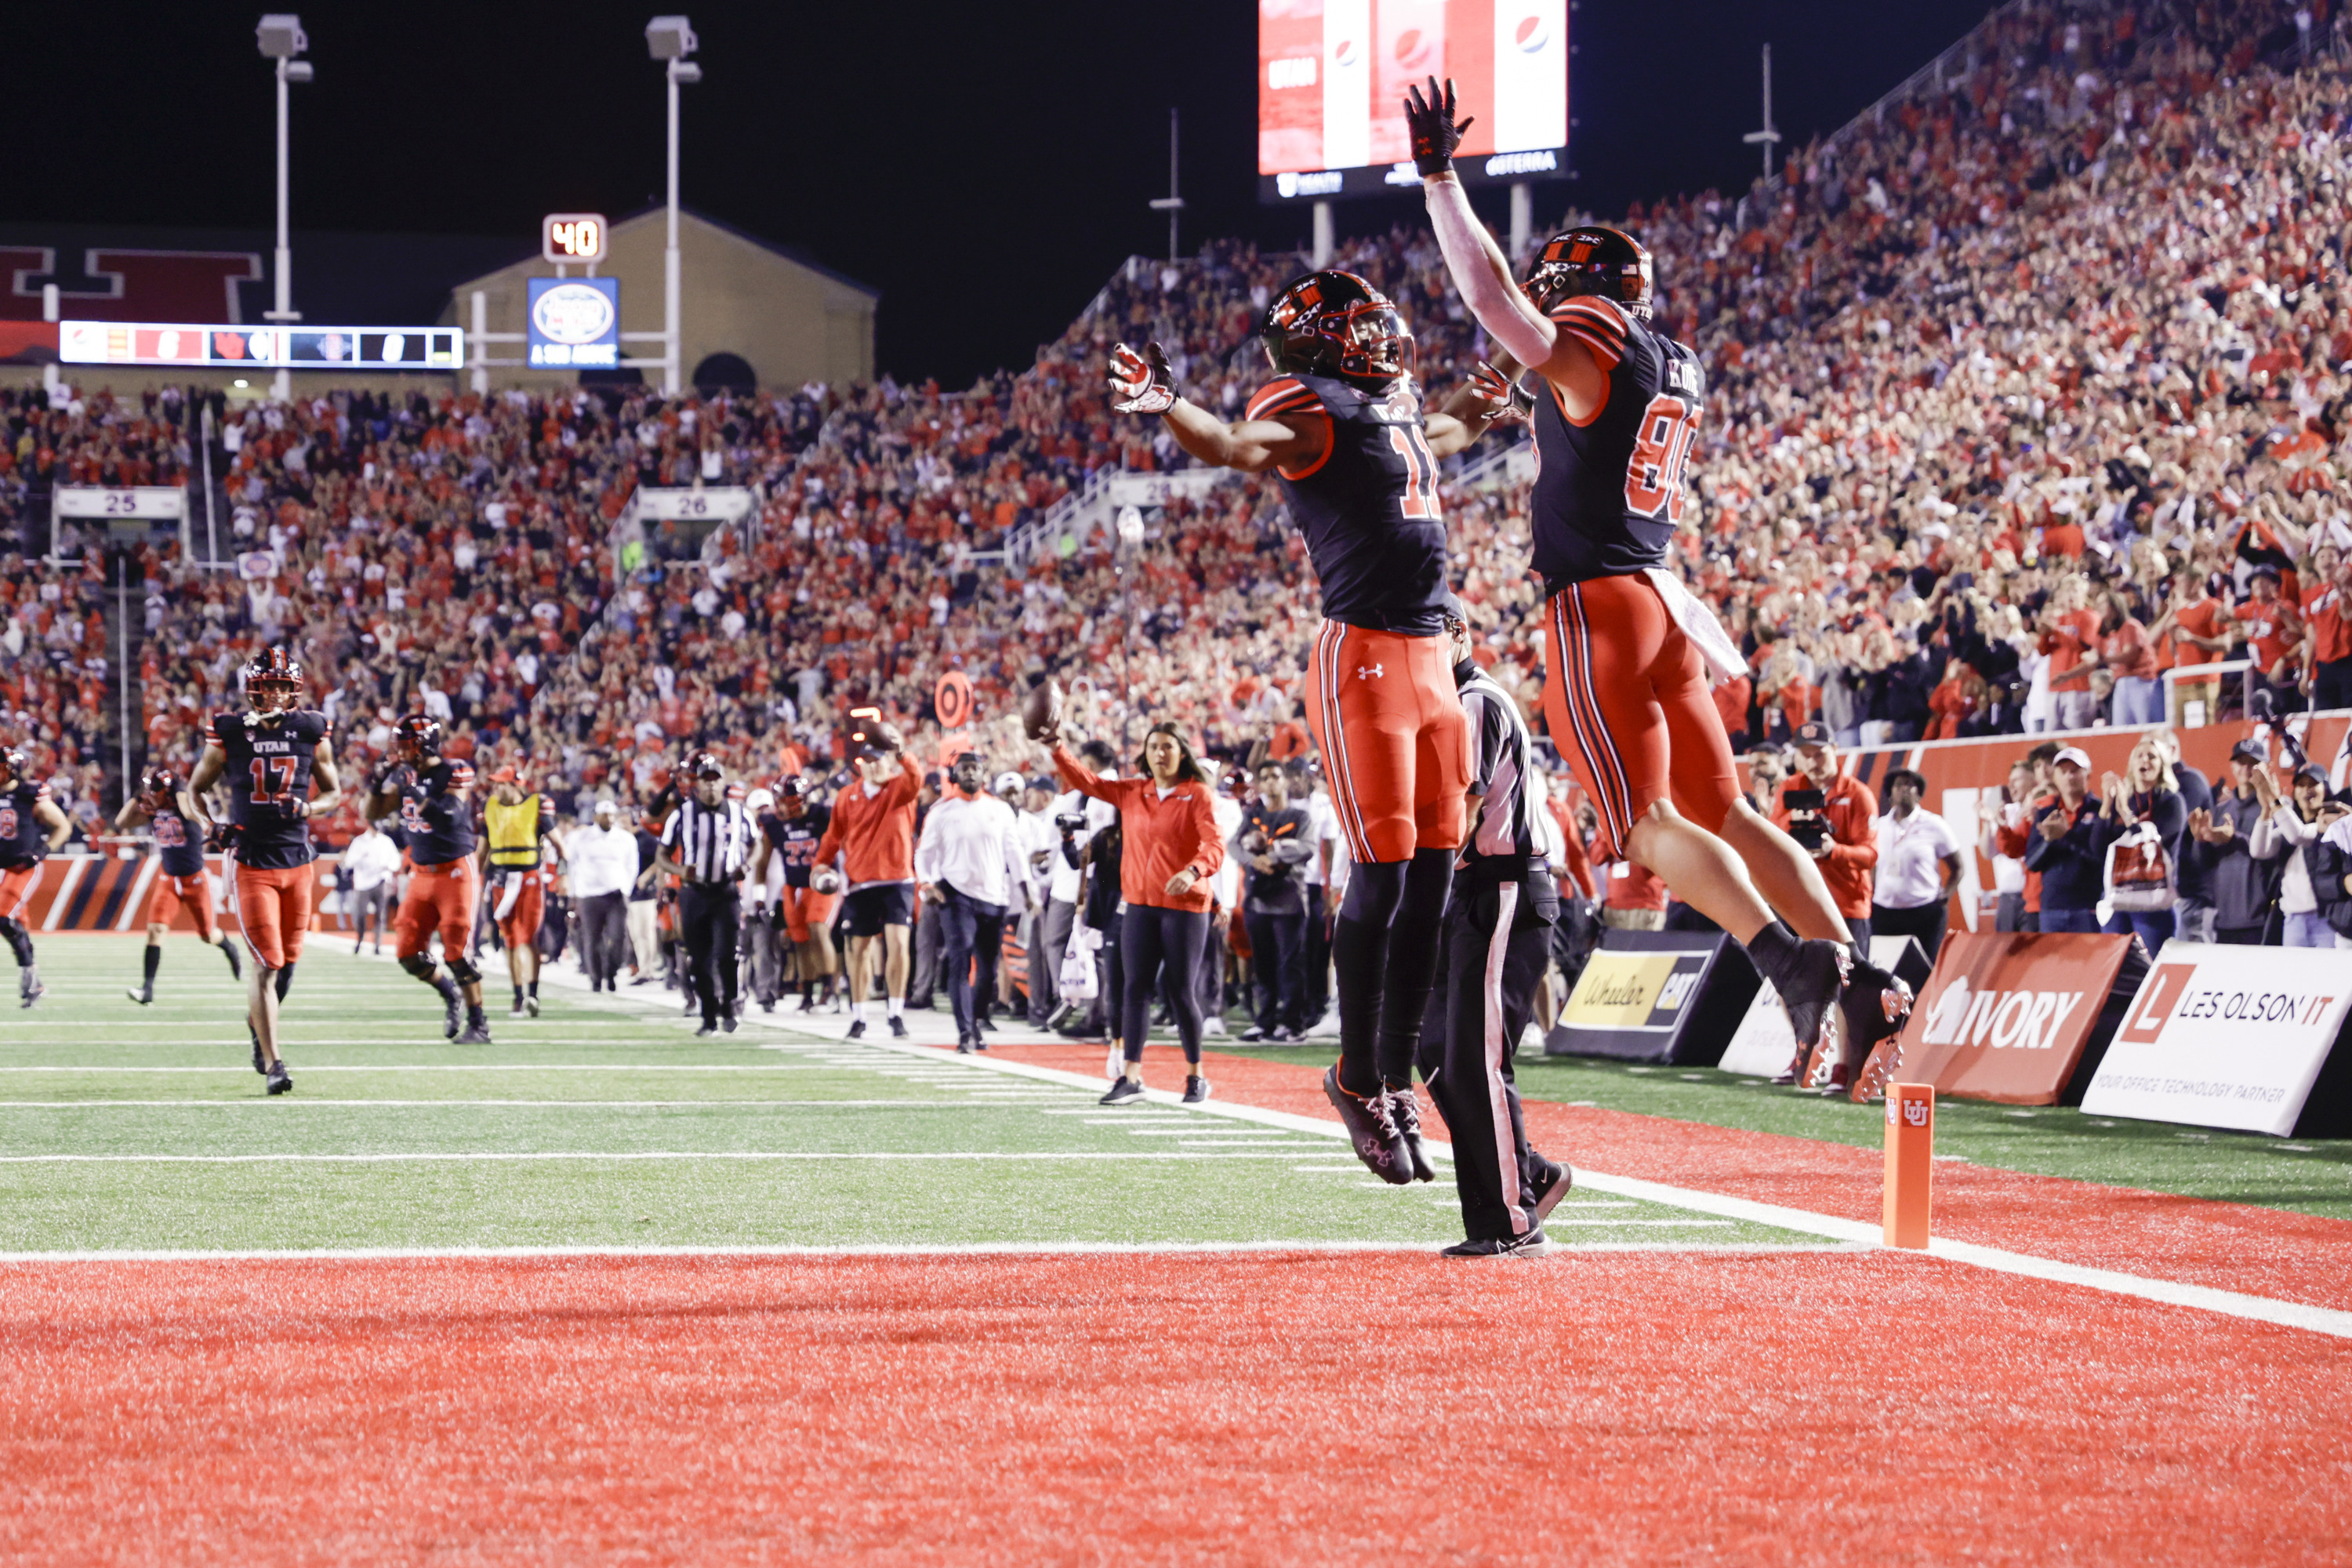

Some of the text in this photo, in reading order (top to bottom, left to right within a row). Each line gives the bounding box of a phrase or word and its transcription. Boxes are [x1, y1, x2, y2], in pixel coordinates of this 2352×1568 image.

[553, 221, 598, 256] 40
[1388, 425, 1442, 520] 11
[105, 495, 136, 512] 25
[678, 496, 707, 514] 26
[253, 741, 290, 753] UTAH
[249, 755, 299, 804] 17
[1584, 973, 1699, 1010] Wheeler CAT
[2180, 991, 2223, 1018] LES
[2302, 996, 2335, 1025] IT
[1953, 989, 2085, 1049] IVORY
[2096, 1073, 2285, 1103] YOUR OFFICE TECHNOLOGY PARTNER
